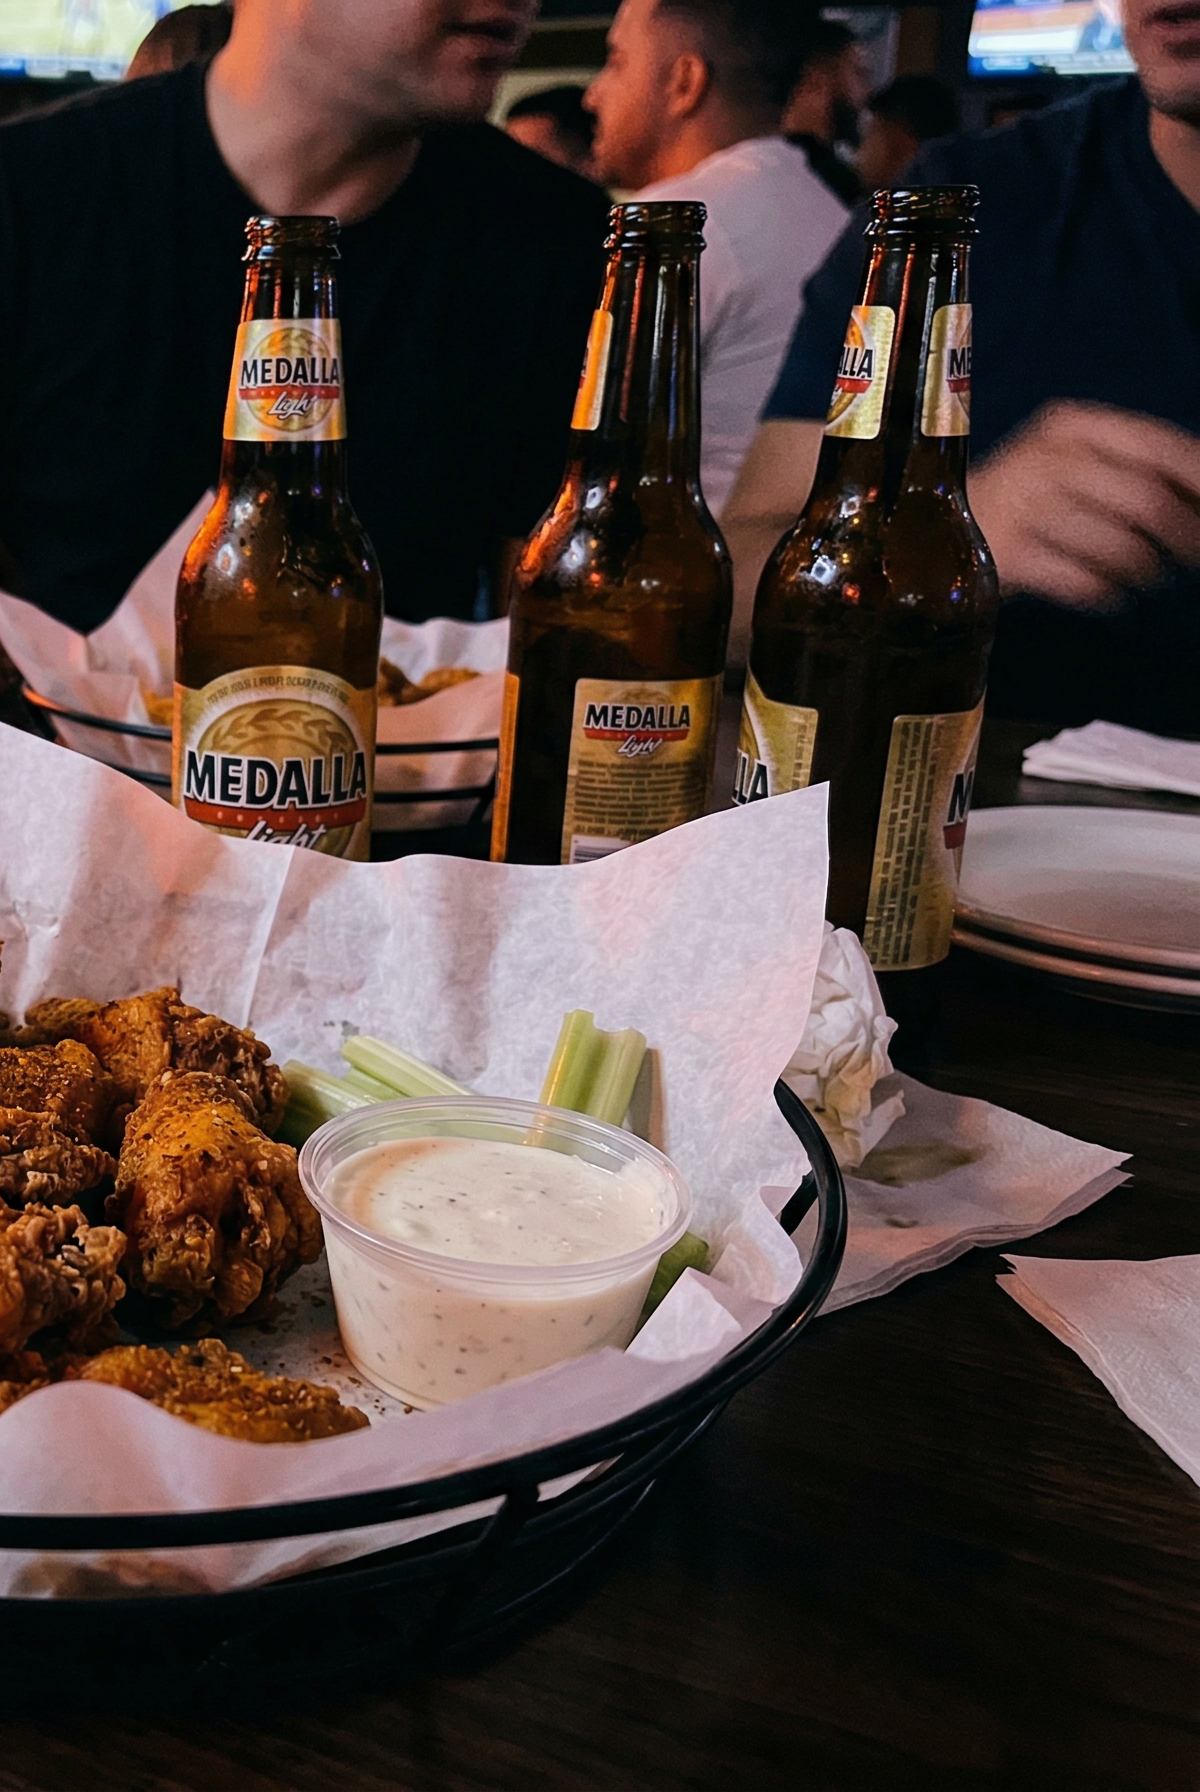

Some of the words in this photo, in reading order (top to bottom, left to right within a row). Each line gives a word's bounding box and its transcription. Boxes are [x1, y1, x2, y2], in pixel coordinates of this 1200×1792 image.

[240, 356, 341, 387] MEDALLA
[838, 346, 874, 379] LLA
[267, 391, 318, 420] Light
[583, 703, 691, 730] MEDALLA
[184, 749, 368, 809] MEDALLA
